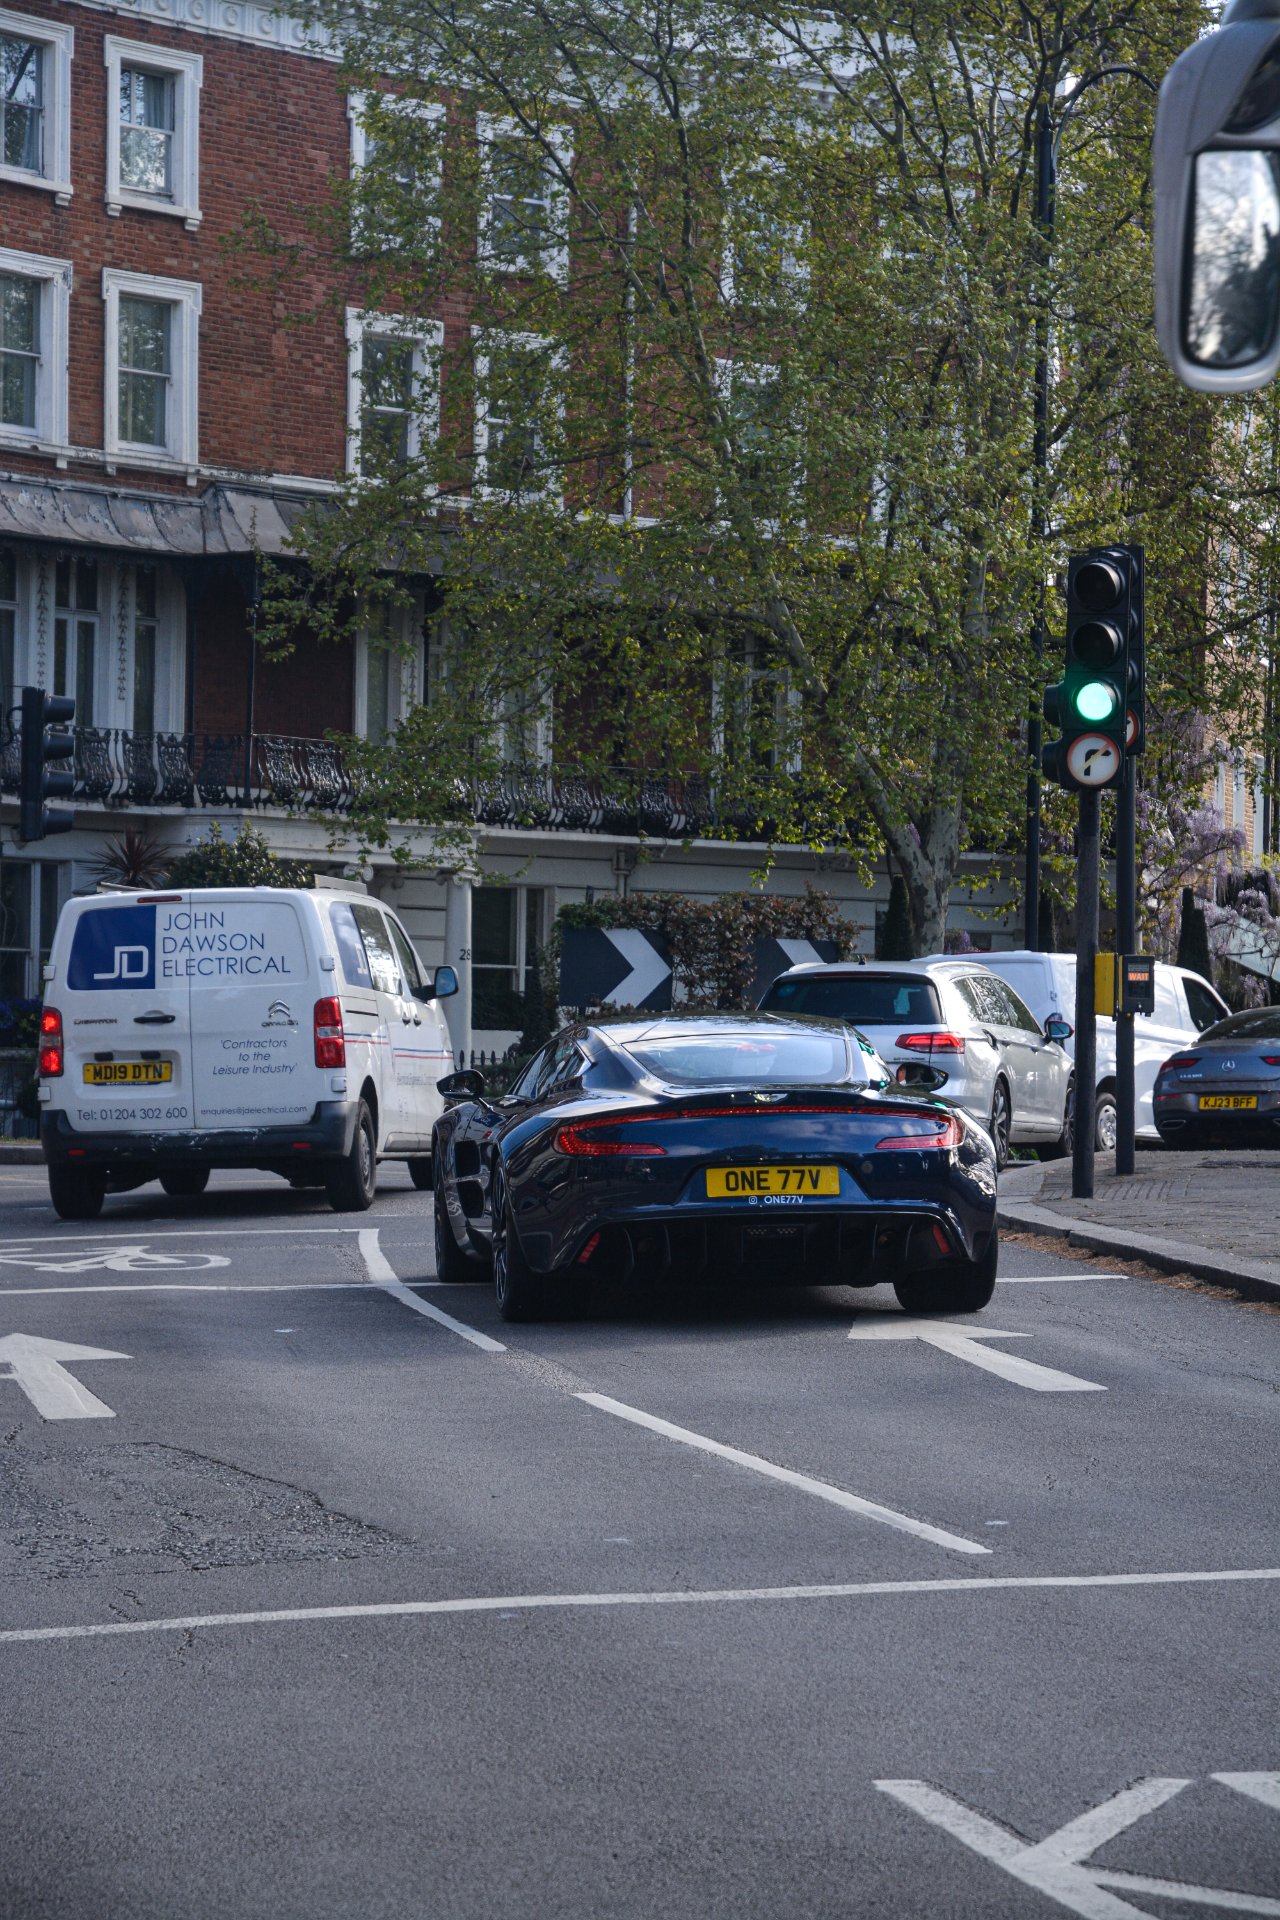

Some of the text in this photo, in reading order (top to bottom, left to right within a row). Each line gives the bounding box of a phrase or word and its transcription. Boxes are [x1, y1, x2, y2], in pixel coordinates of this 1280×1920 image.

[162, 911, 225, 932] JOHN
[162, 932, 265, 954] DAWSON
[93, 945, 149, 980] JD
[162, 955, 291, 978] ELECTRICAL
[1128, 972, 1150, 981] WAIT
[238, 1051, 271, 1062] to the
[92, 1063, 163, 1081] MD19 DTN
[212, 1063, 250, 1075] Leisure
[1203, 1096, 1253, 1108] KJ23 BFF
[77, 1106, 188, 1121] Tel: 01204 302 600
[200, 1105, 308, 1116] enquiries@jdelectrical.com
[725, 1169, 821, 1192] ONE 77V
[763, 1195, 804, 1205] ONE77V
